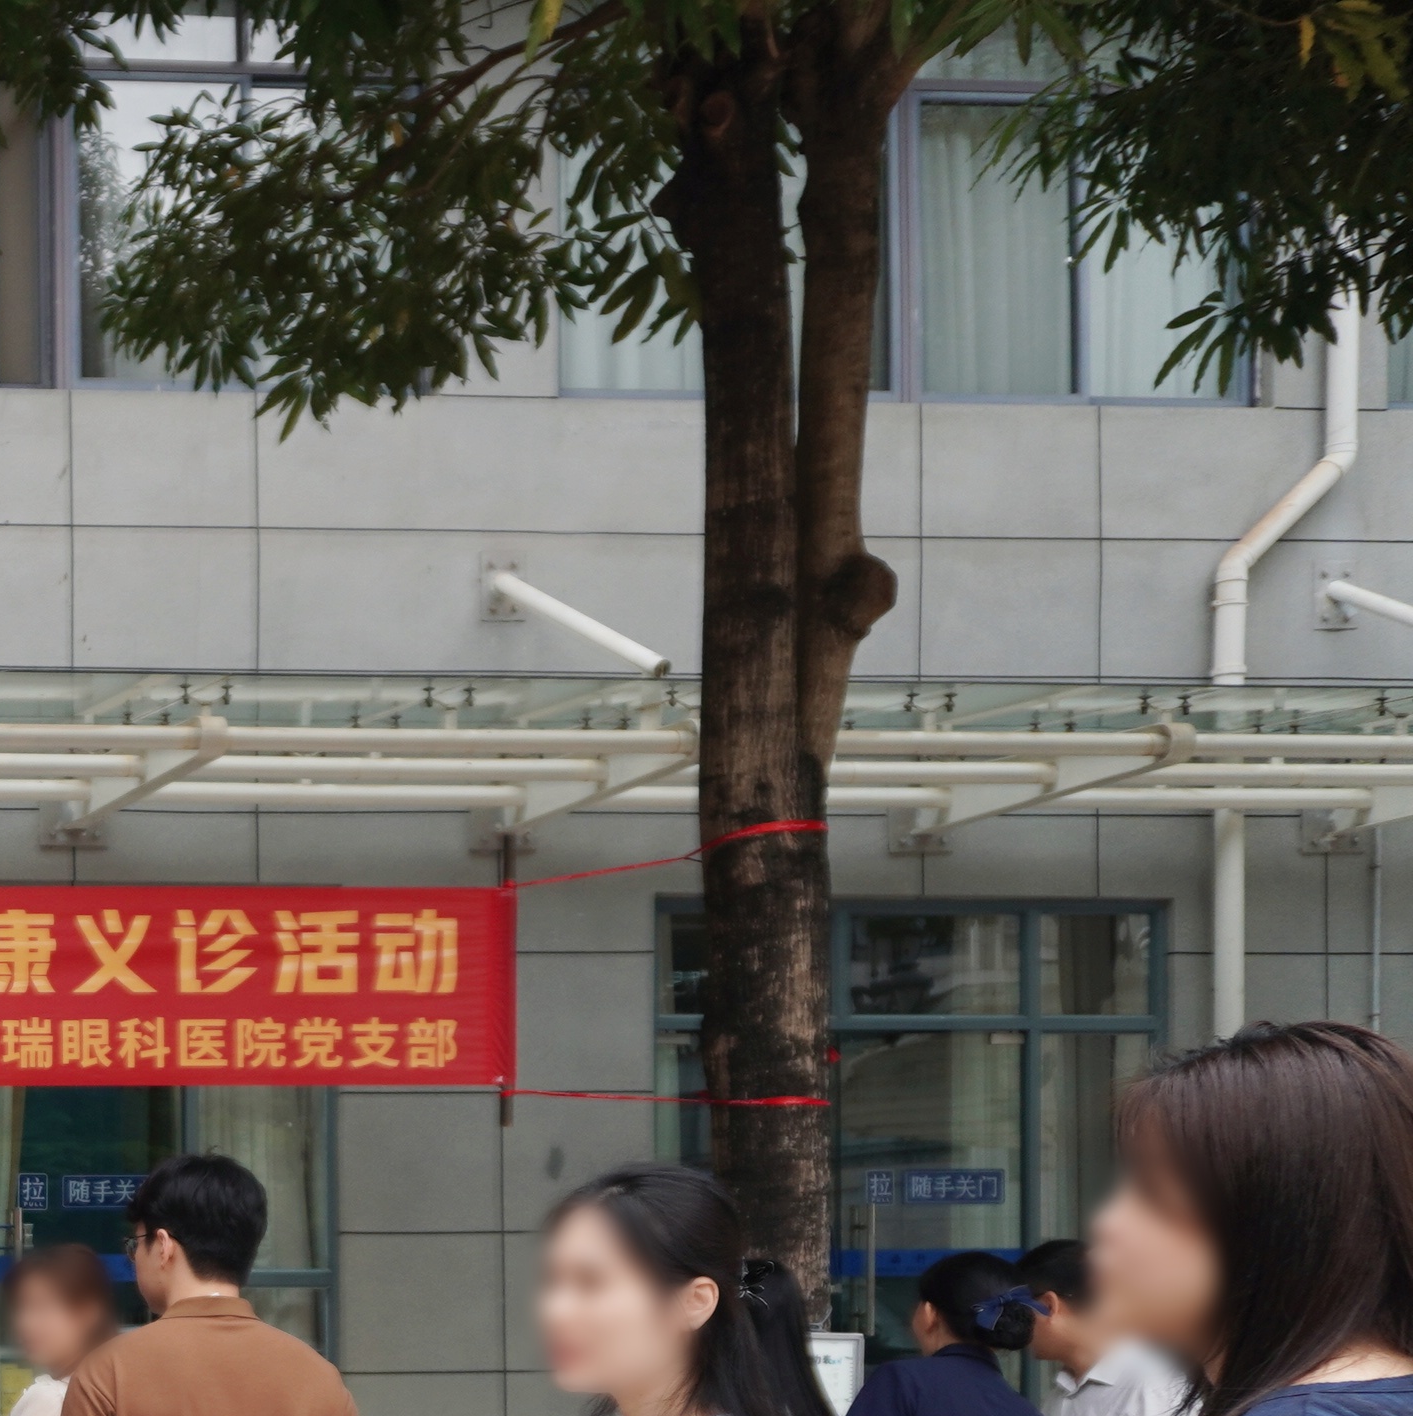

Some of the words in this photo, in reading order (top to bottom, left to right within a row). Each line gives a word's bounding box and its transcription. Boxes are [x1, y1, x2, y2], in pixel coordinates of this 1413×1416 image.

[22, 1177, 45, 1201] 拉
[69, 1179, 137, 1204] 随手关
[870, 1174, 892, 1197] 拉
[911, 1175, 998, 1199] 随手关门
